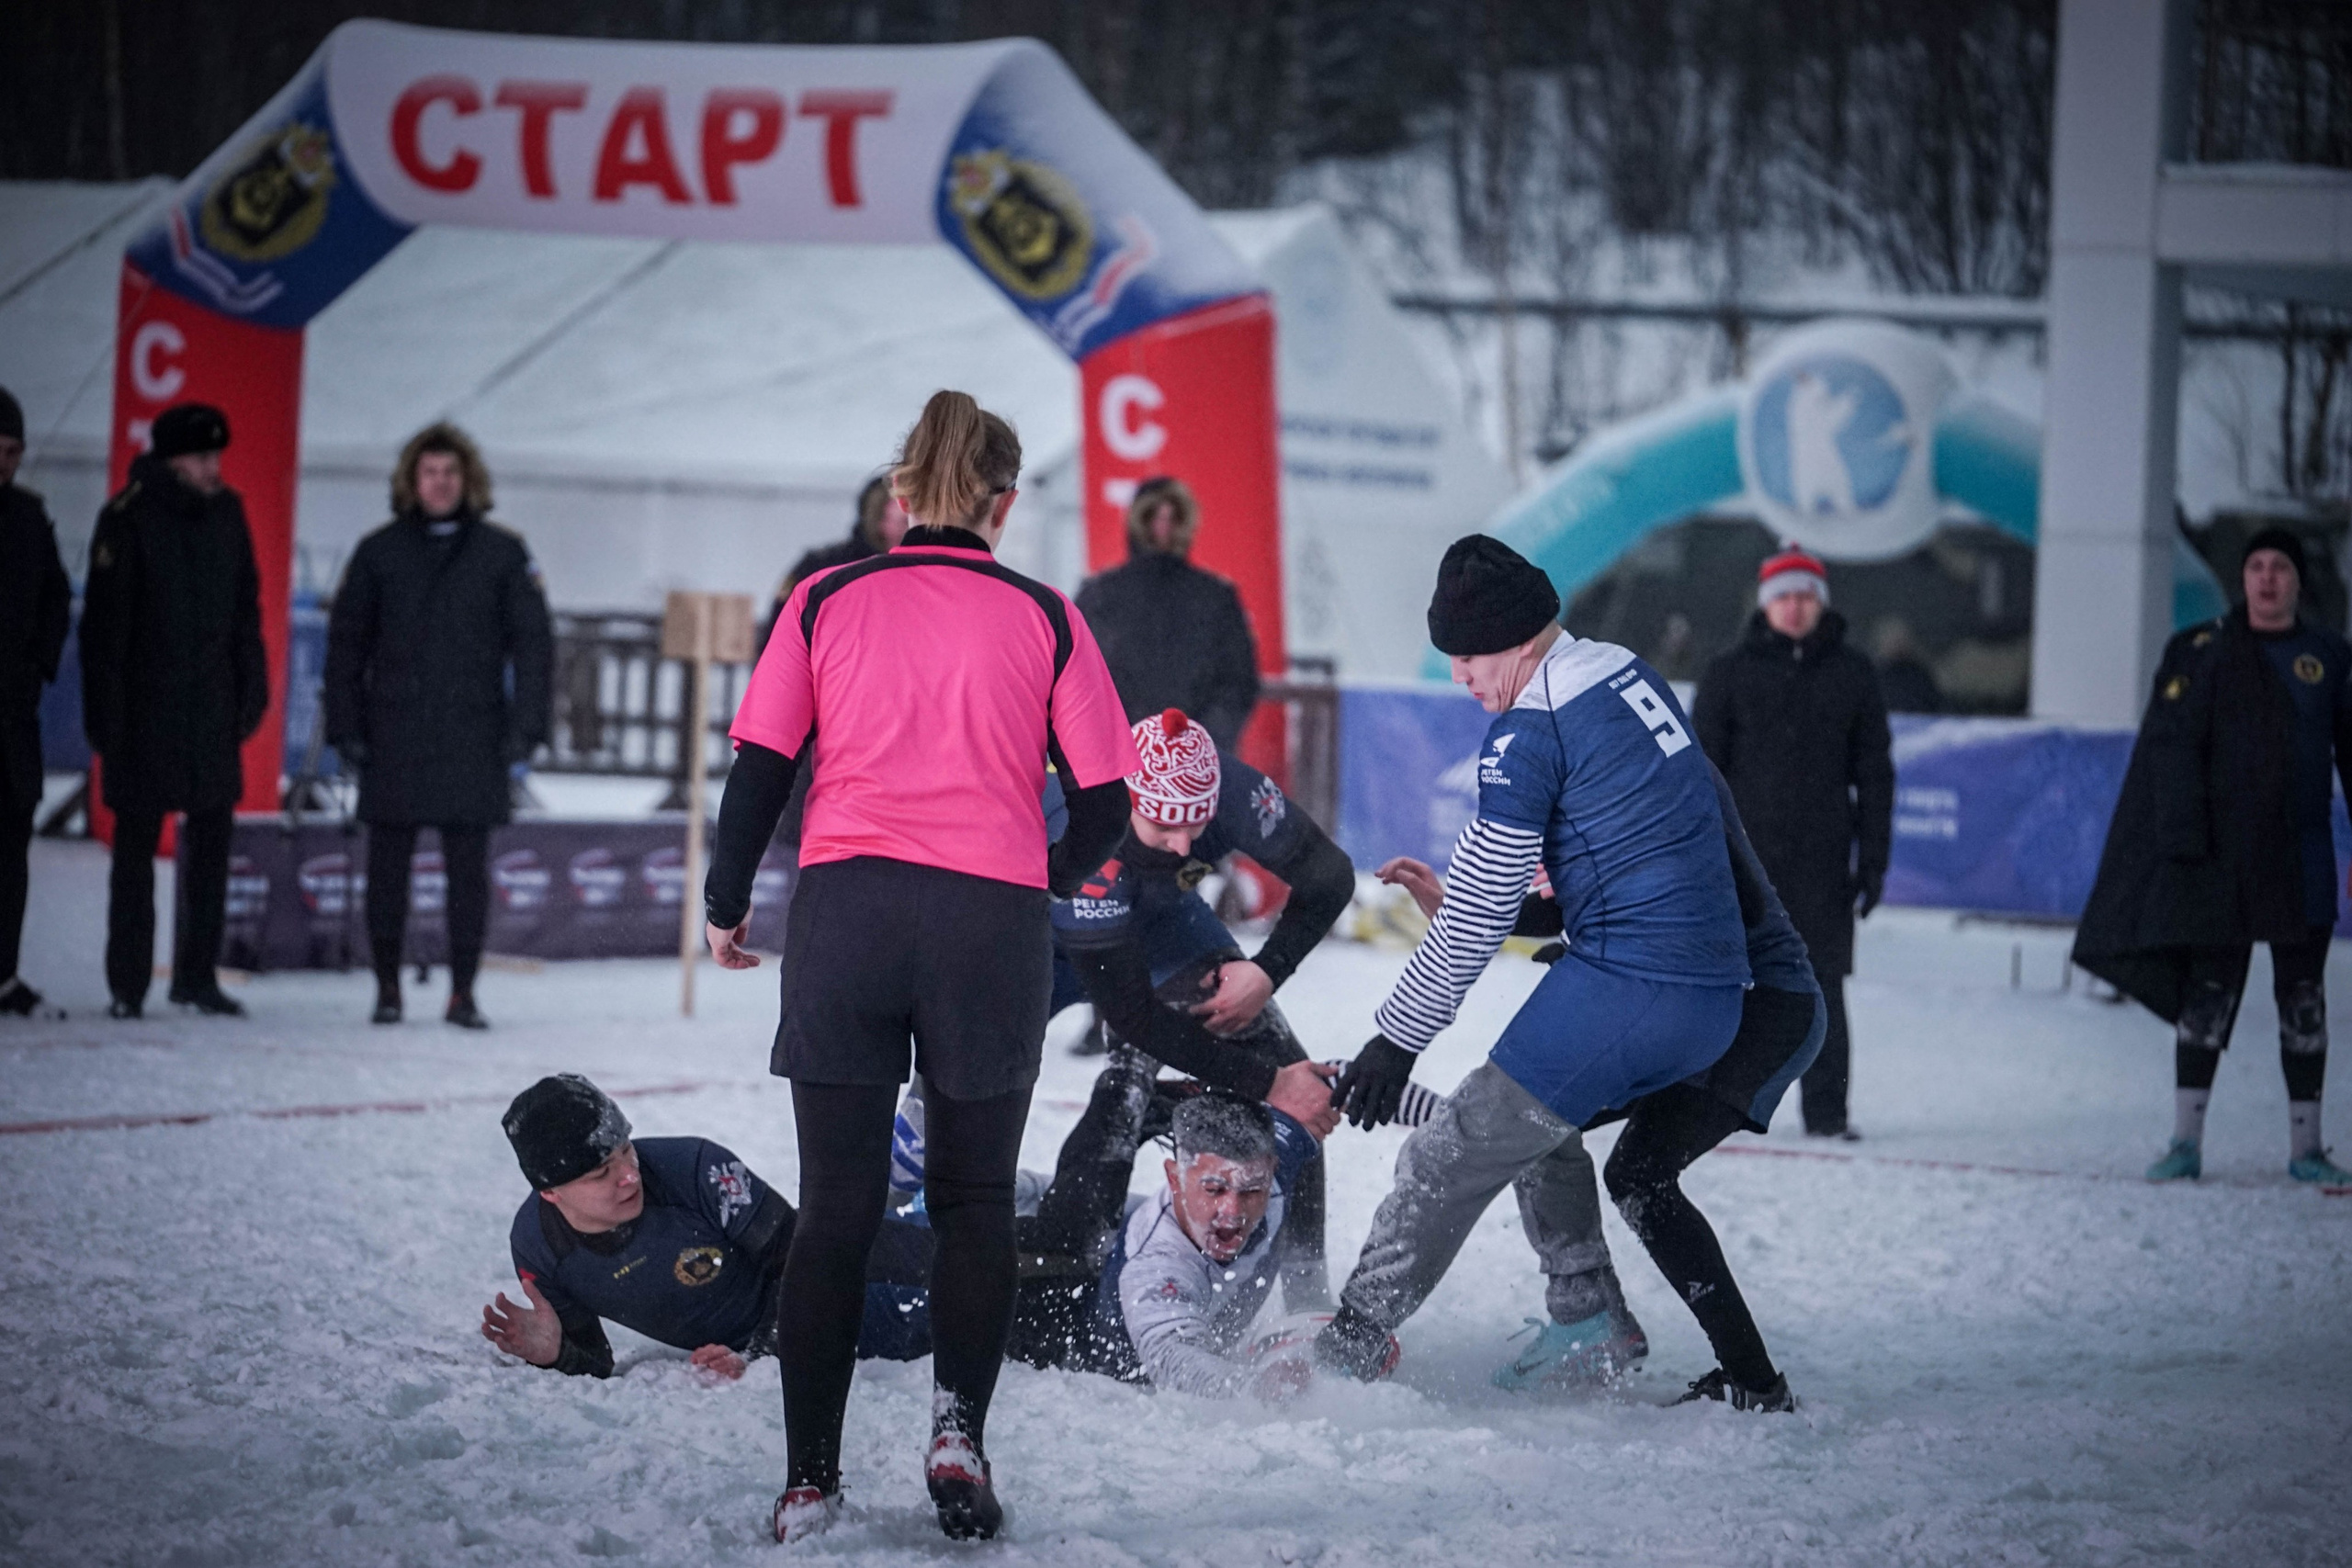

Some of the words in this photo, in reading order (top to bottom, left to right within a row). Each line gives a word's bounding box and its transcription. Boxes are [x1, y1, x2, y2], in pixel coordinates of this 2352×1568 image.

[389, 73, 896, 208] СТАРТ
[1619, 678, 1691, 758] 9
[1074, 905, 1130, 919] РОССИИ
